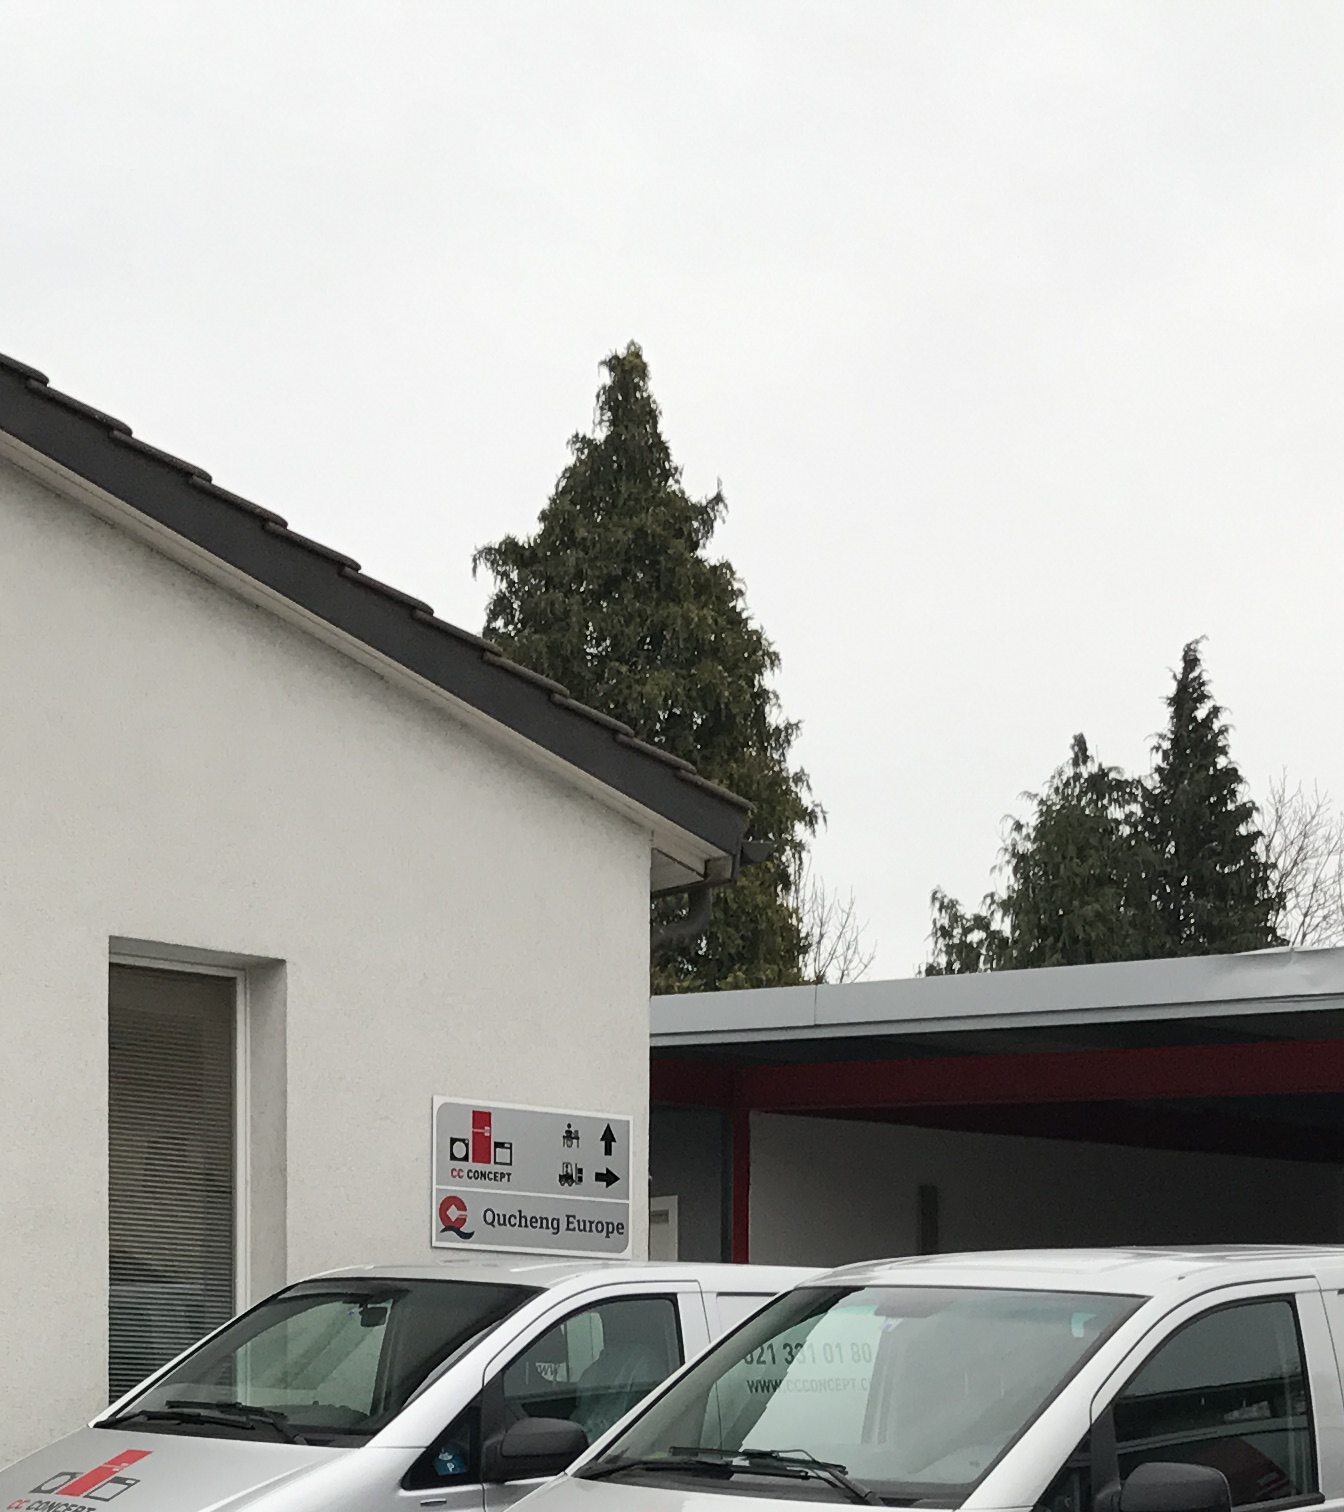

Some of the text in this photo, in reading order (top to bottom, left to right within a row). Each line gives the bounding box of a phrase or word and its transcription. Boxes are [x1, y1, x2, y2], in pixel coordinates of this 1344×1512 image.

[450, 1168, 512, 1183] CC CONCEPT
[483, 1208, 625, 1238] Qucheng Europe
[782, 1342, 816, 1365] 331
[823, 1342, 844, 1364] 01
[851, 1342, 872, 1364] 80
[746, 1378, 872, 1394] WWW.CCCONCEPT.C
